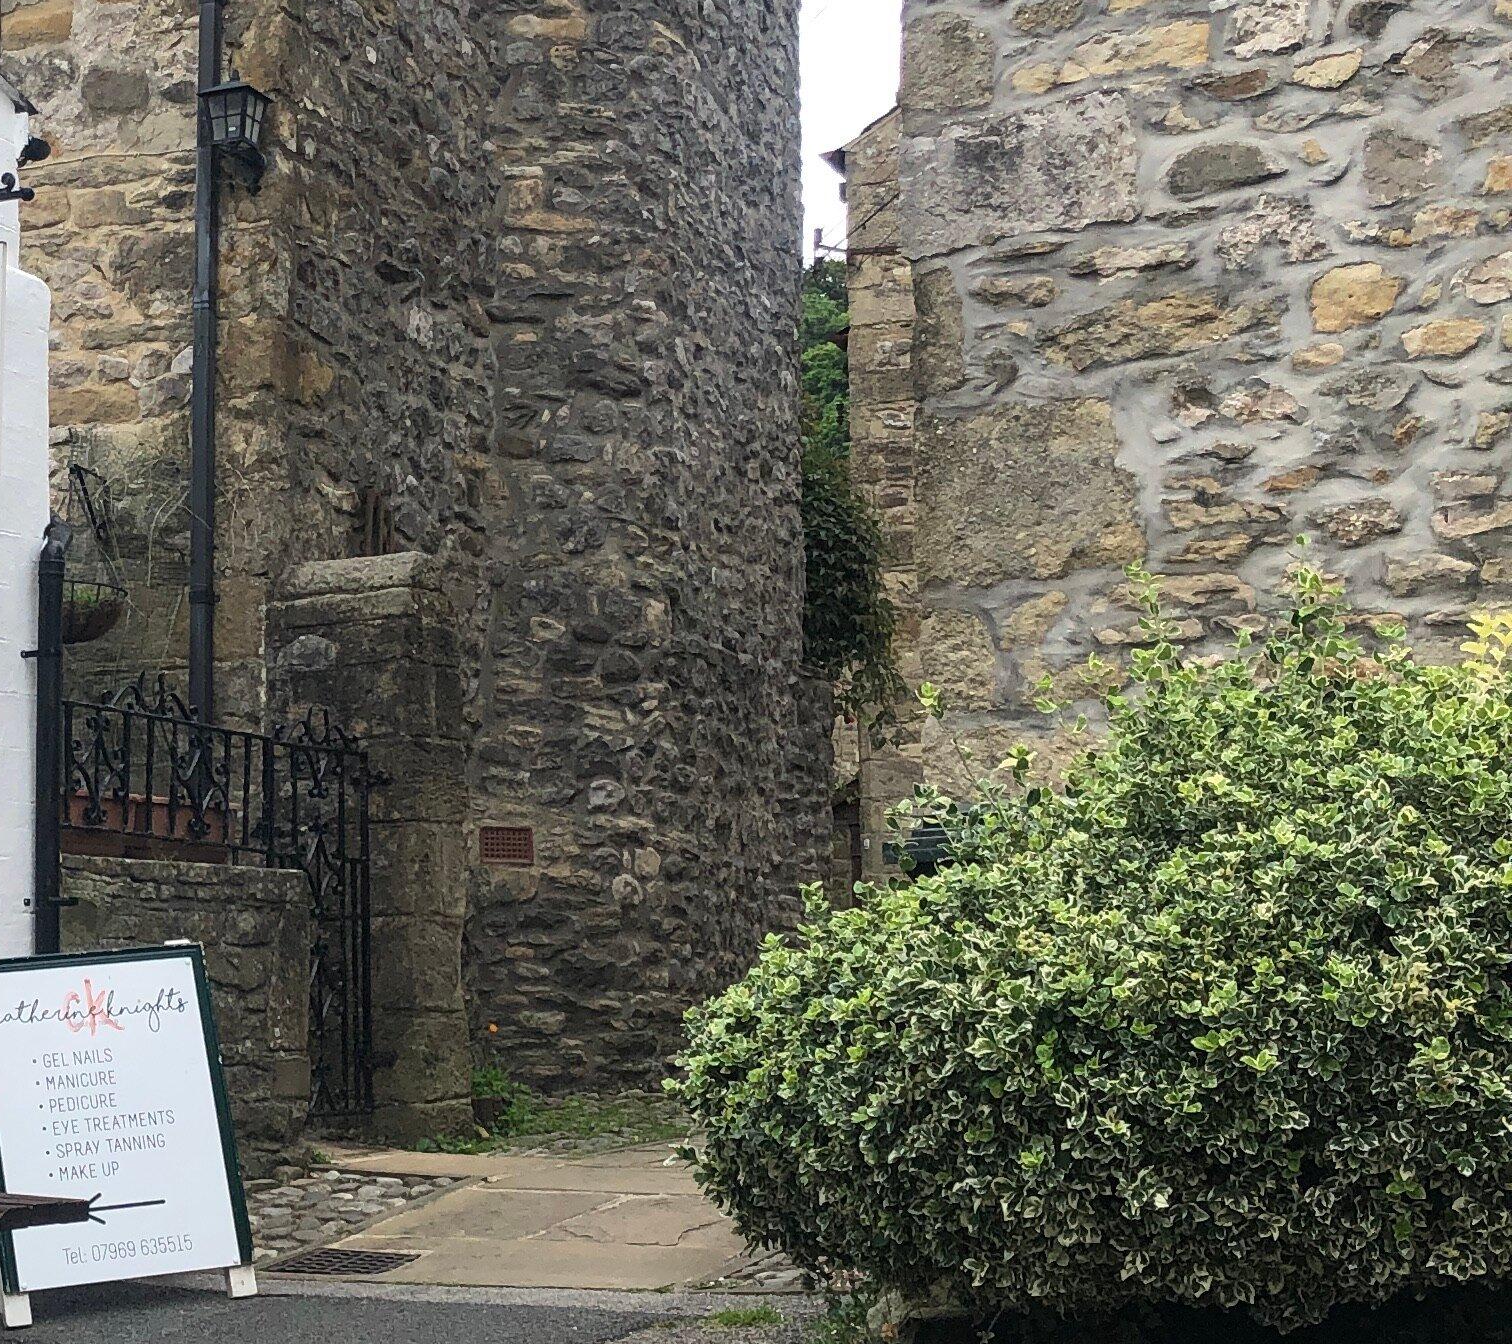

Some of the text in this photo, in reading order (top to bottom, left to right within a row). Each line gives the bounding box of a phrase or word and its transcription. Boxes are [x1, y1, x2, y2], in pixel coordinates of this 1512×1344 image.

[106, 987, 188, 1033] knights
[42, 1048, 113, 1068] GEL NAILS
[45, 1070, 117, 1091] MANICURE
[49, 1092, 118, 1113] PEDICURE
[52, 1109, 176, 1136] EYE TREATMENTS
[55, 1133, 166, 1159] SPRAY TANNING
[59, 1160, 120, 1181] MAKE UP
[62, 1233, 193, 1266] Tel: 07969 635515
